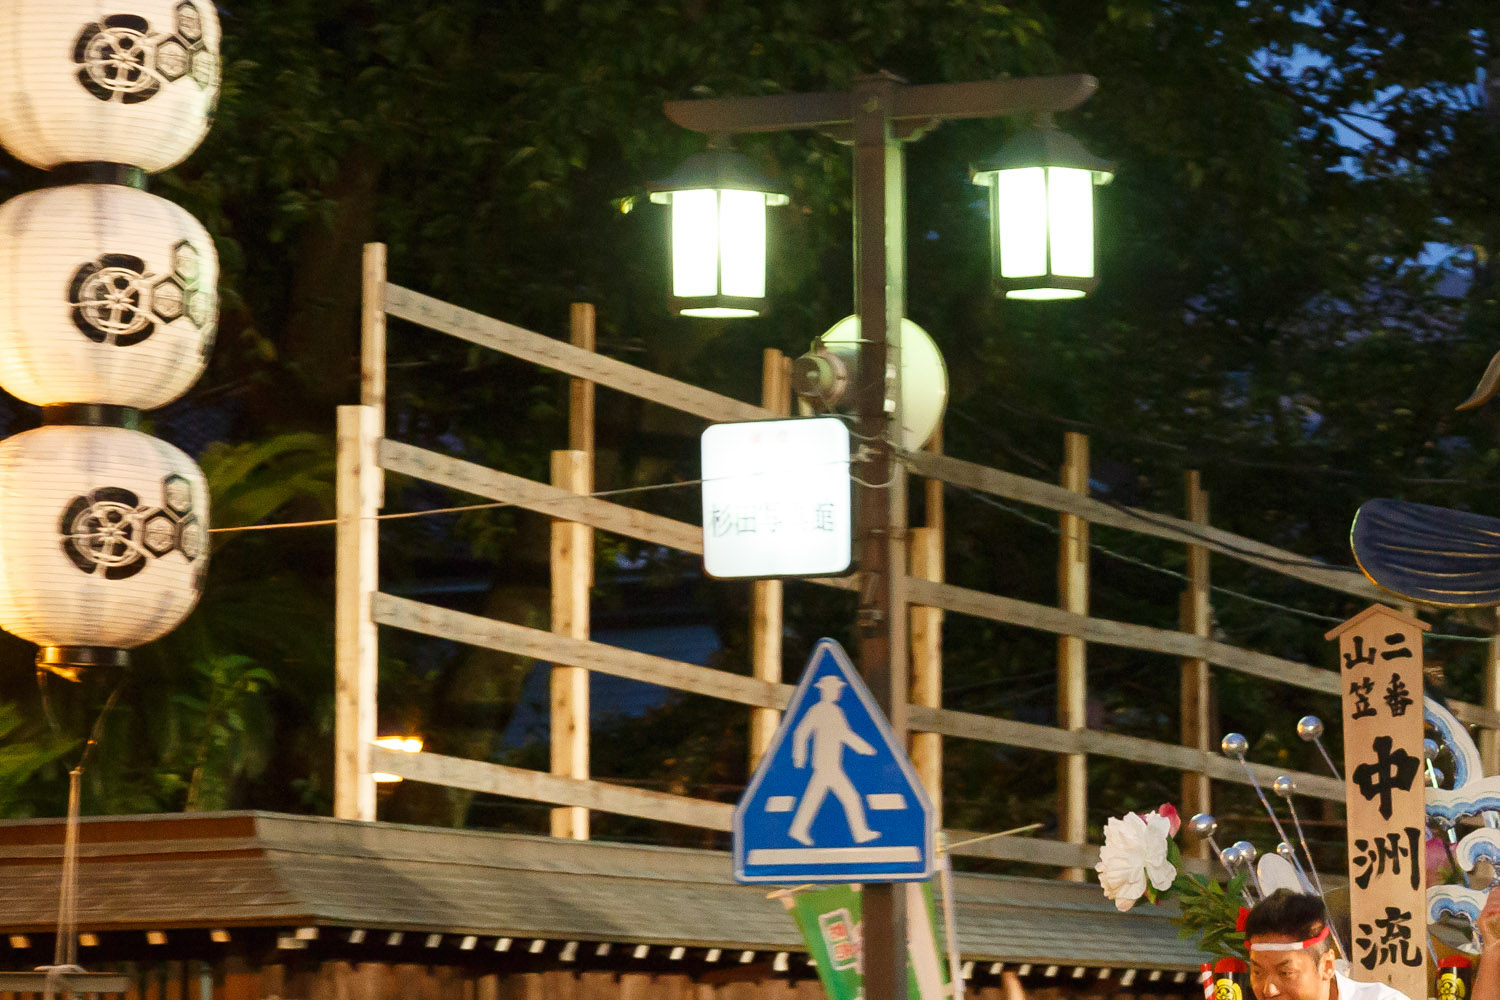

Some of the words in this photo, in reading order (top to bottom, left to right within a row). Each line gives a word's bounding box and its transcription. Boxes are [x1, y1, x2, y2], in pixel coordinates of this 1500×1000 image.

[1343, 635, 1377, 720] 山笠
[1381, 632, 1414, 718] 二番
[1352, 735, 1423, 972] 中洲流
